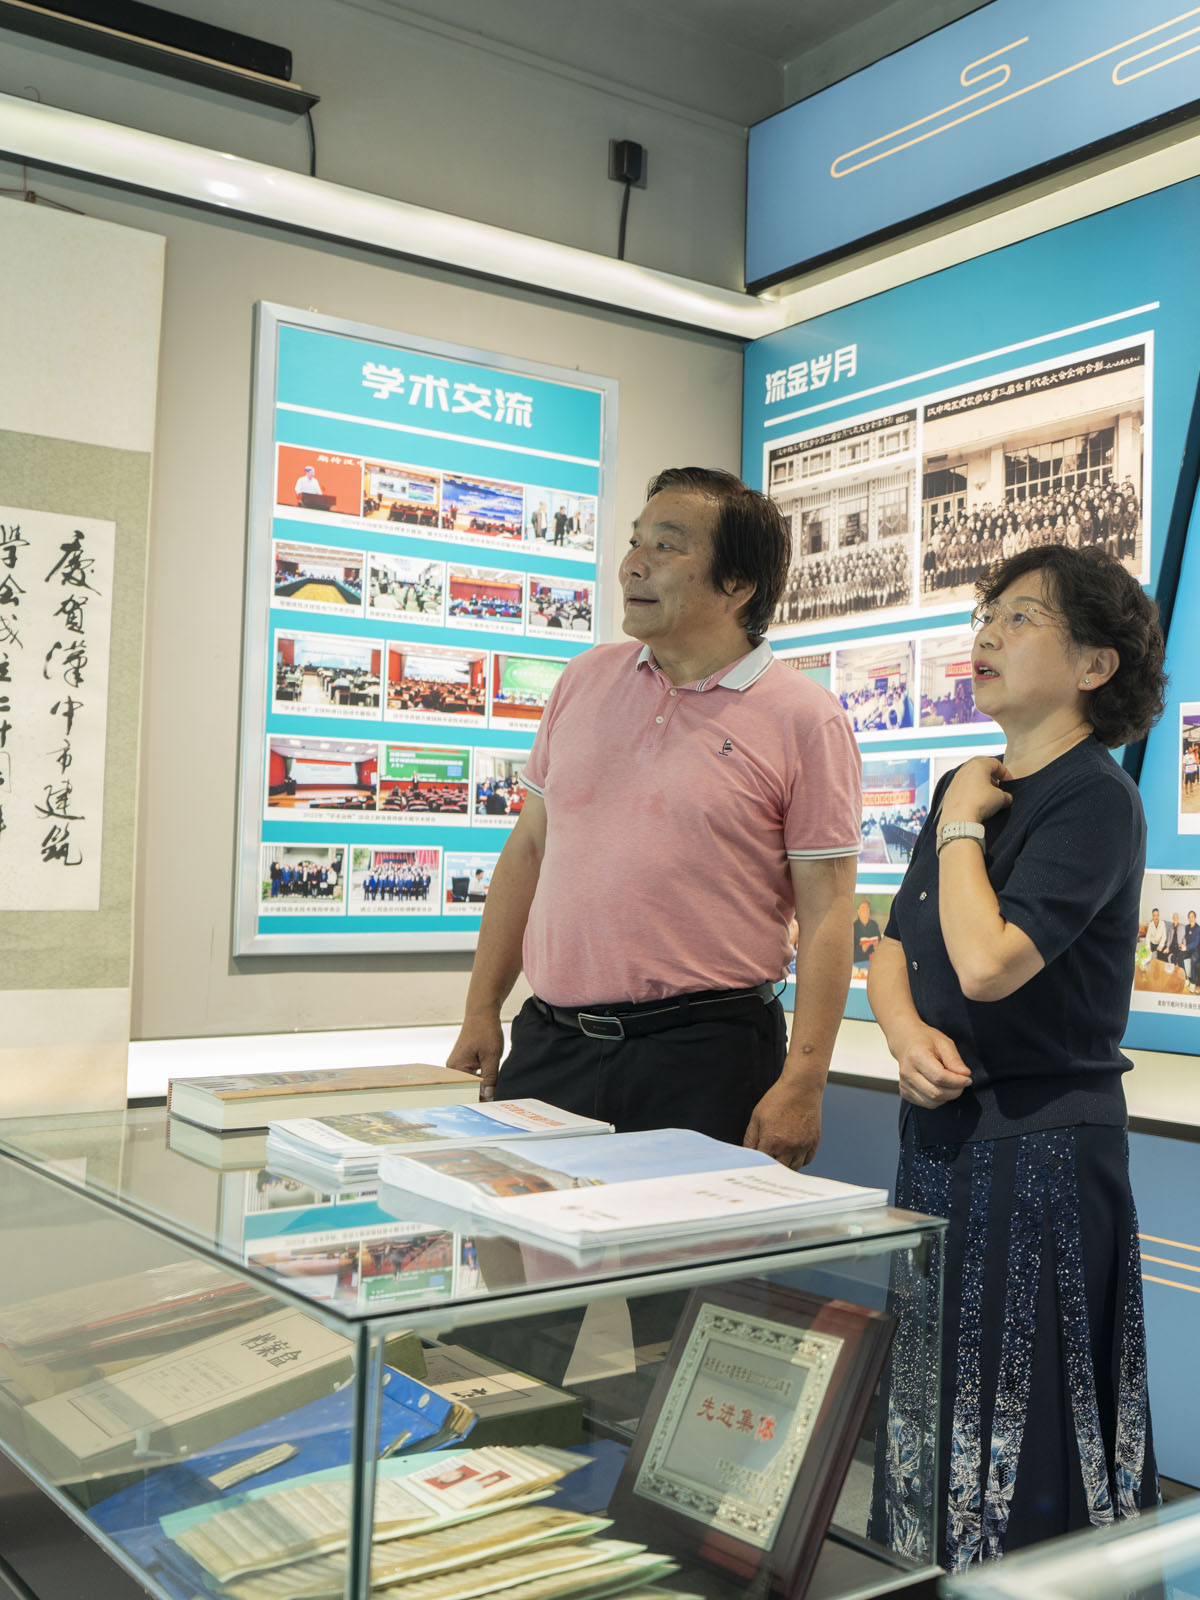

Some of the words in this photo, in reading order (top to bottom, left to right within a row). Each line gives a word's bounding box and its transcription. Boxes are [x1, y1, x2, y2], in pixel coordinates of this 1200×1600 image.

[362, 362, 533, 428] 学术交流
[765, 344, 858, 404] 流金岁月
[696, 1395, 776, 1441] 先进集体
